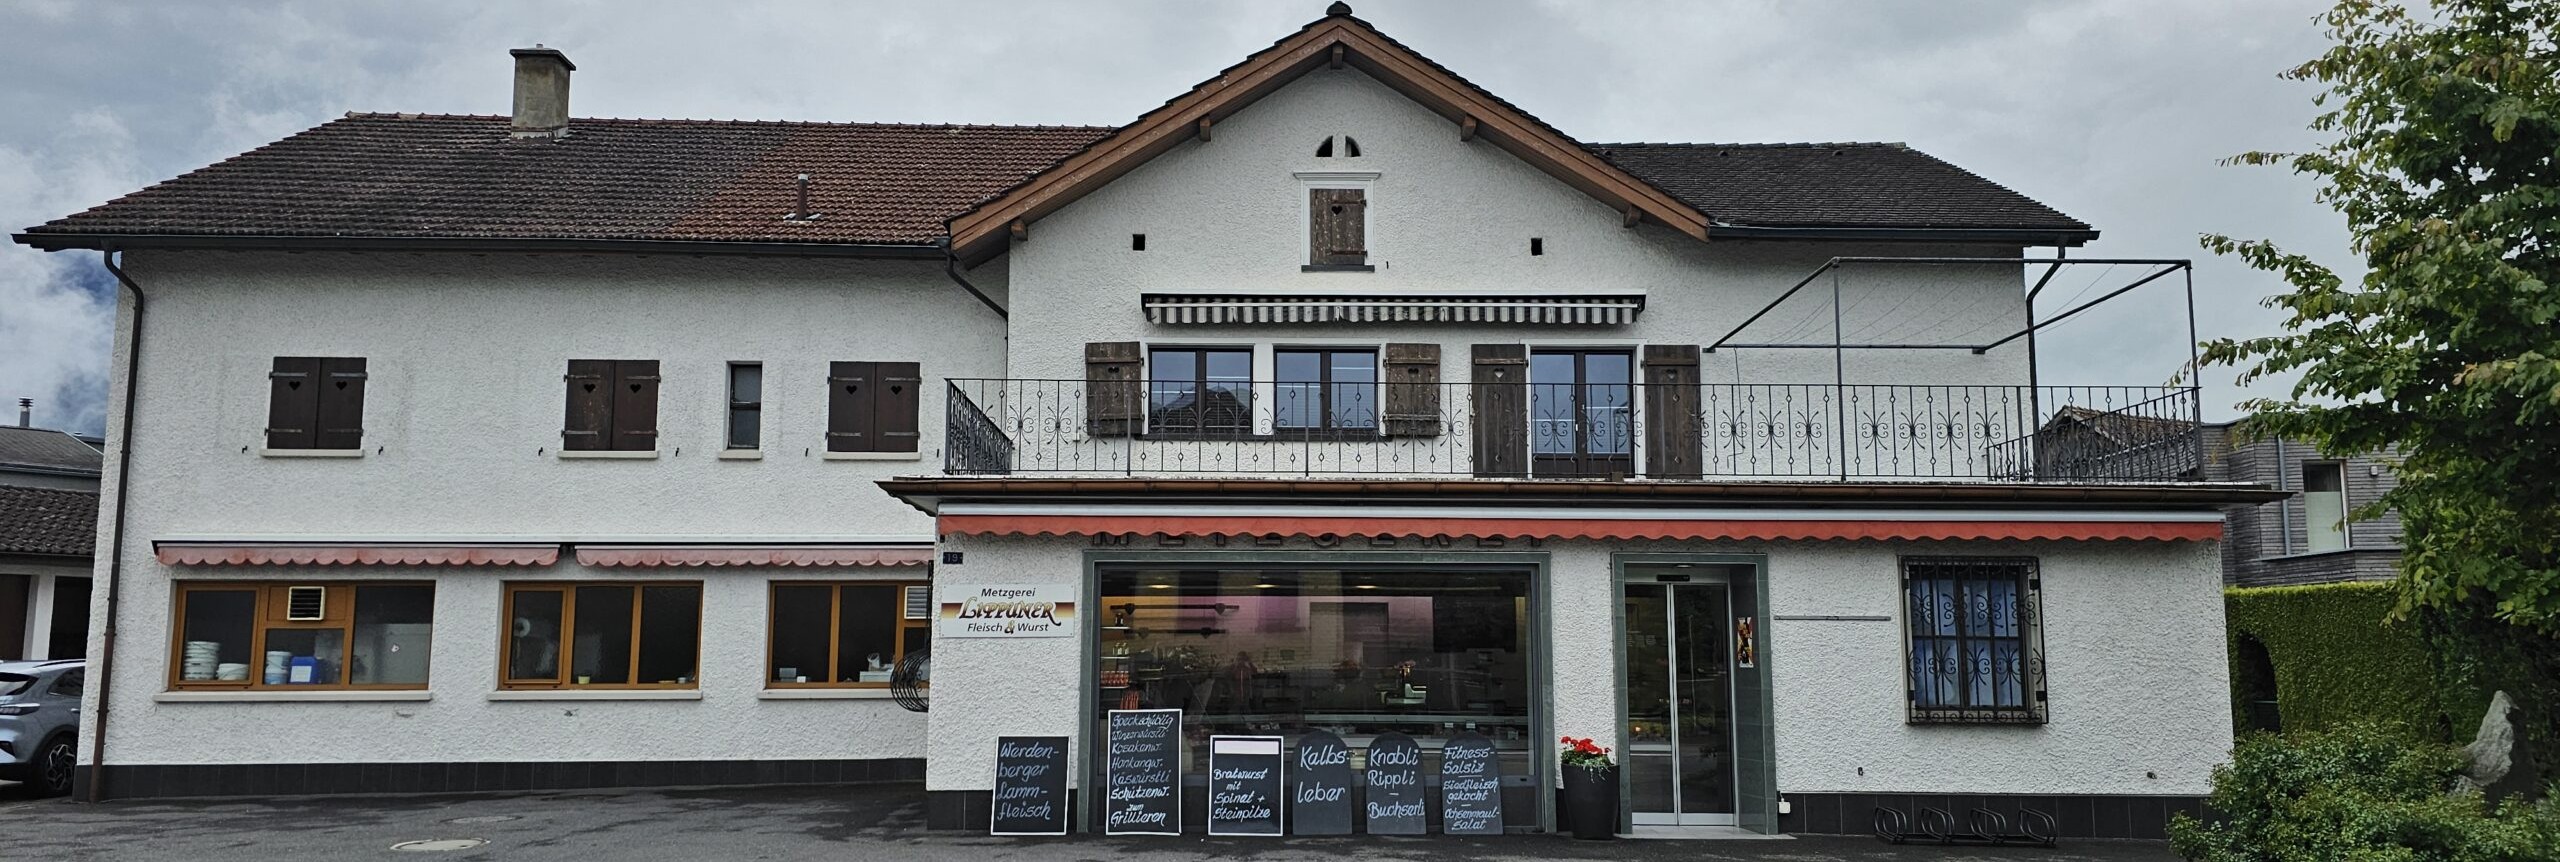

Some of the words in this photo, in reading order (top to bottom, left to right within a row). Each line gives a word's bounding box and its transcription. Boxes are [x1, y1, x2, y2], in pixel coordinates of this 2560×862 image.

[947, 553, 959, 562] 19
[981, 587, 1036, 599] Metzgerei
[967, 622, 1003, 632] Fleisch
[1004, 619, 1015, 634] &
[1017, 623, 1049, 632] Wurst
[1000, 741, 1060, 759] Werden-
[1444, 746, 1495, 760] Fitness-
[998, 762, 1050, 783] berger
[1213, 768, 1269, 780] Bratwurst
[1442, 760, 1485, 774] Salsiz
[1226, 780, 1242, 791] mit
[1367, 769, 1416, 789] Rippli
[996, 781, 1048, 800] Lamm-
[1213, 790, 1255, 807] Spinat
[1297, 781, 1346, 803] leber
[997, 801, 1051, 821] fleisch
[1212, 805, 1271, 823] Steinpilze
